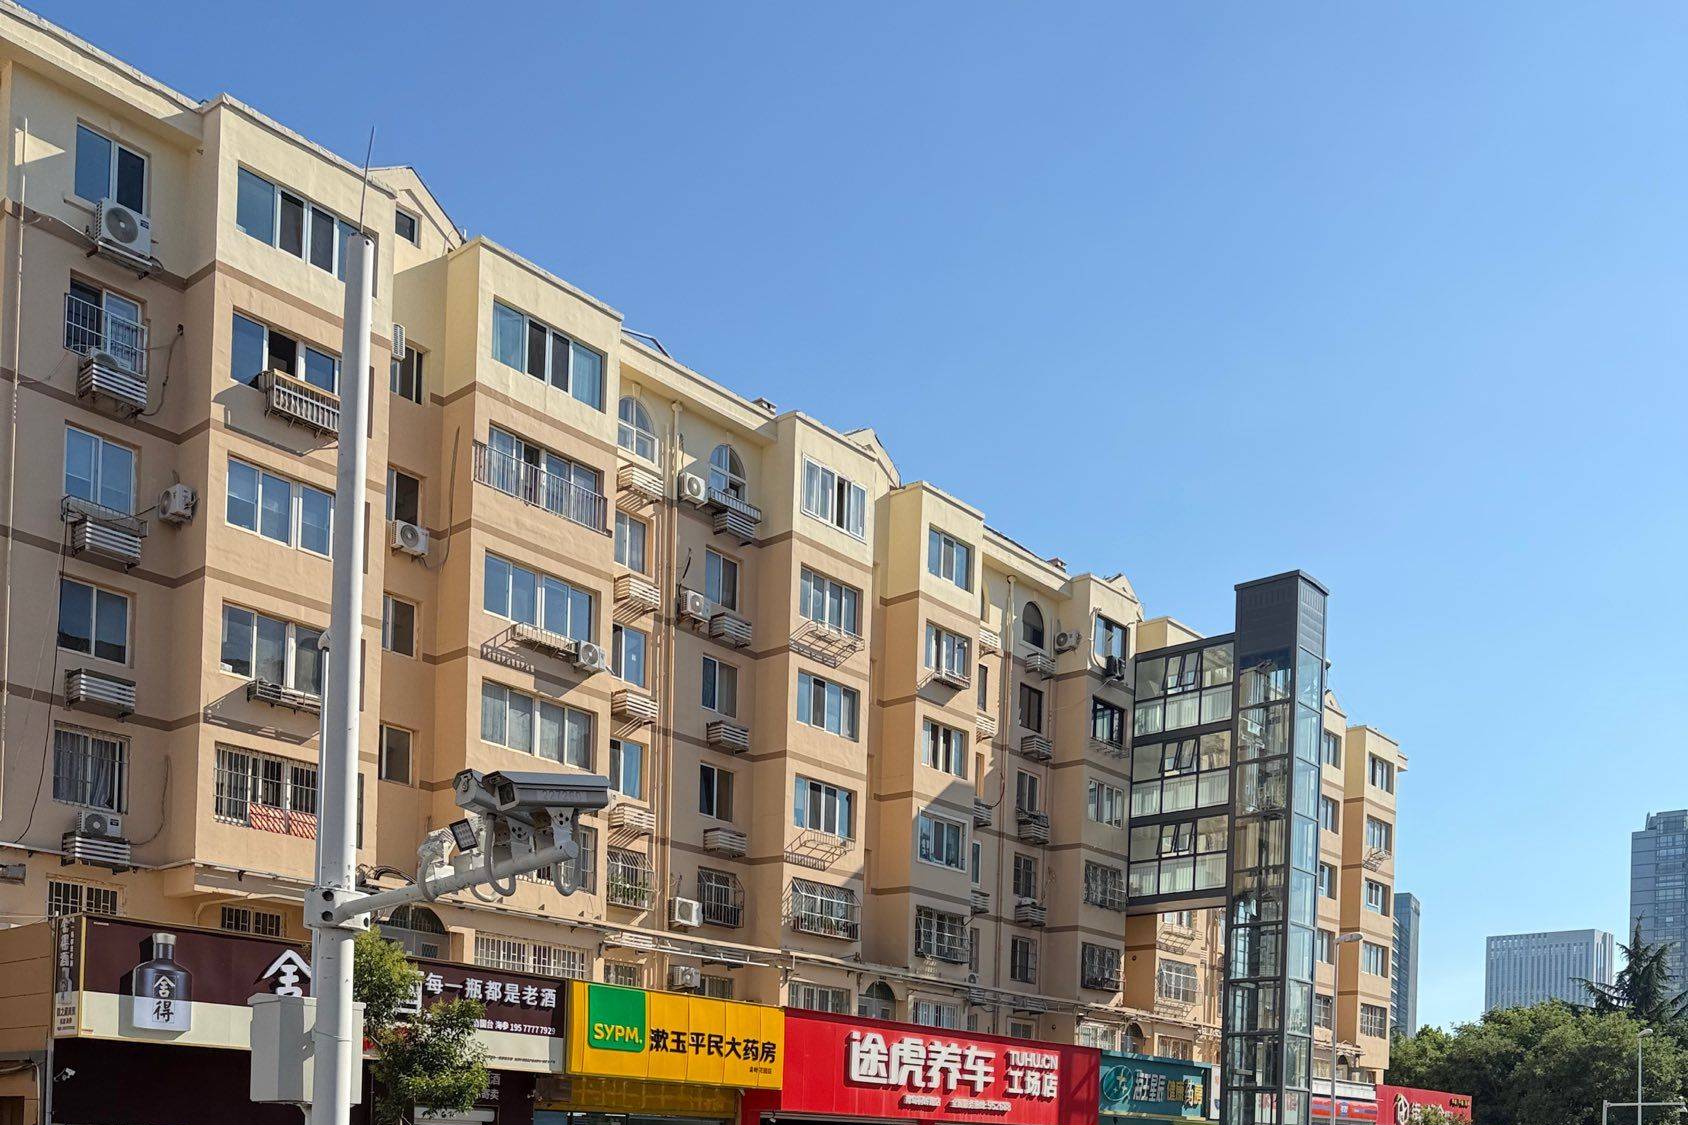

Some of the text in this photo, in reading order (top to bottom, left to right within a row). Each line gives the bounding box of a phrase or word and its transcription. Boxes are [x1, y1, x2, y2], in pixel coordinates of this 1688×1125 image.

[153, 975, 176, 1023] 舍得
[425, 972, 556, 1008] 每一瓶都是老酒
[650, 1028, 777, 1064] 漱玉平民大药房
[849, 1030, 996, 1093] 途虎养车
[1007, 1070, 1058, 1098] 工场店
